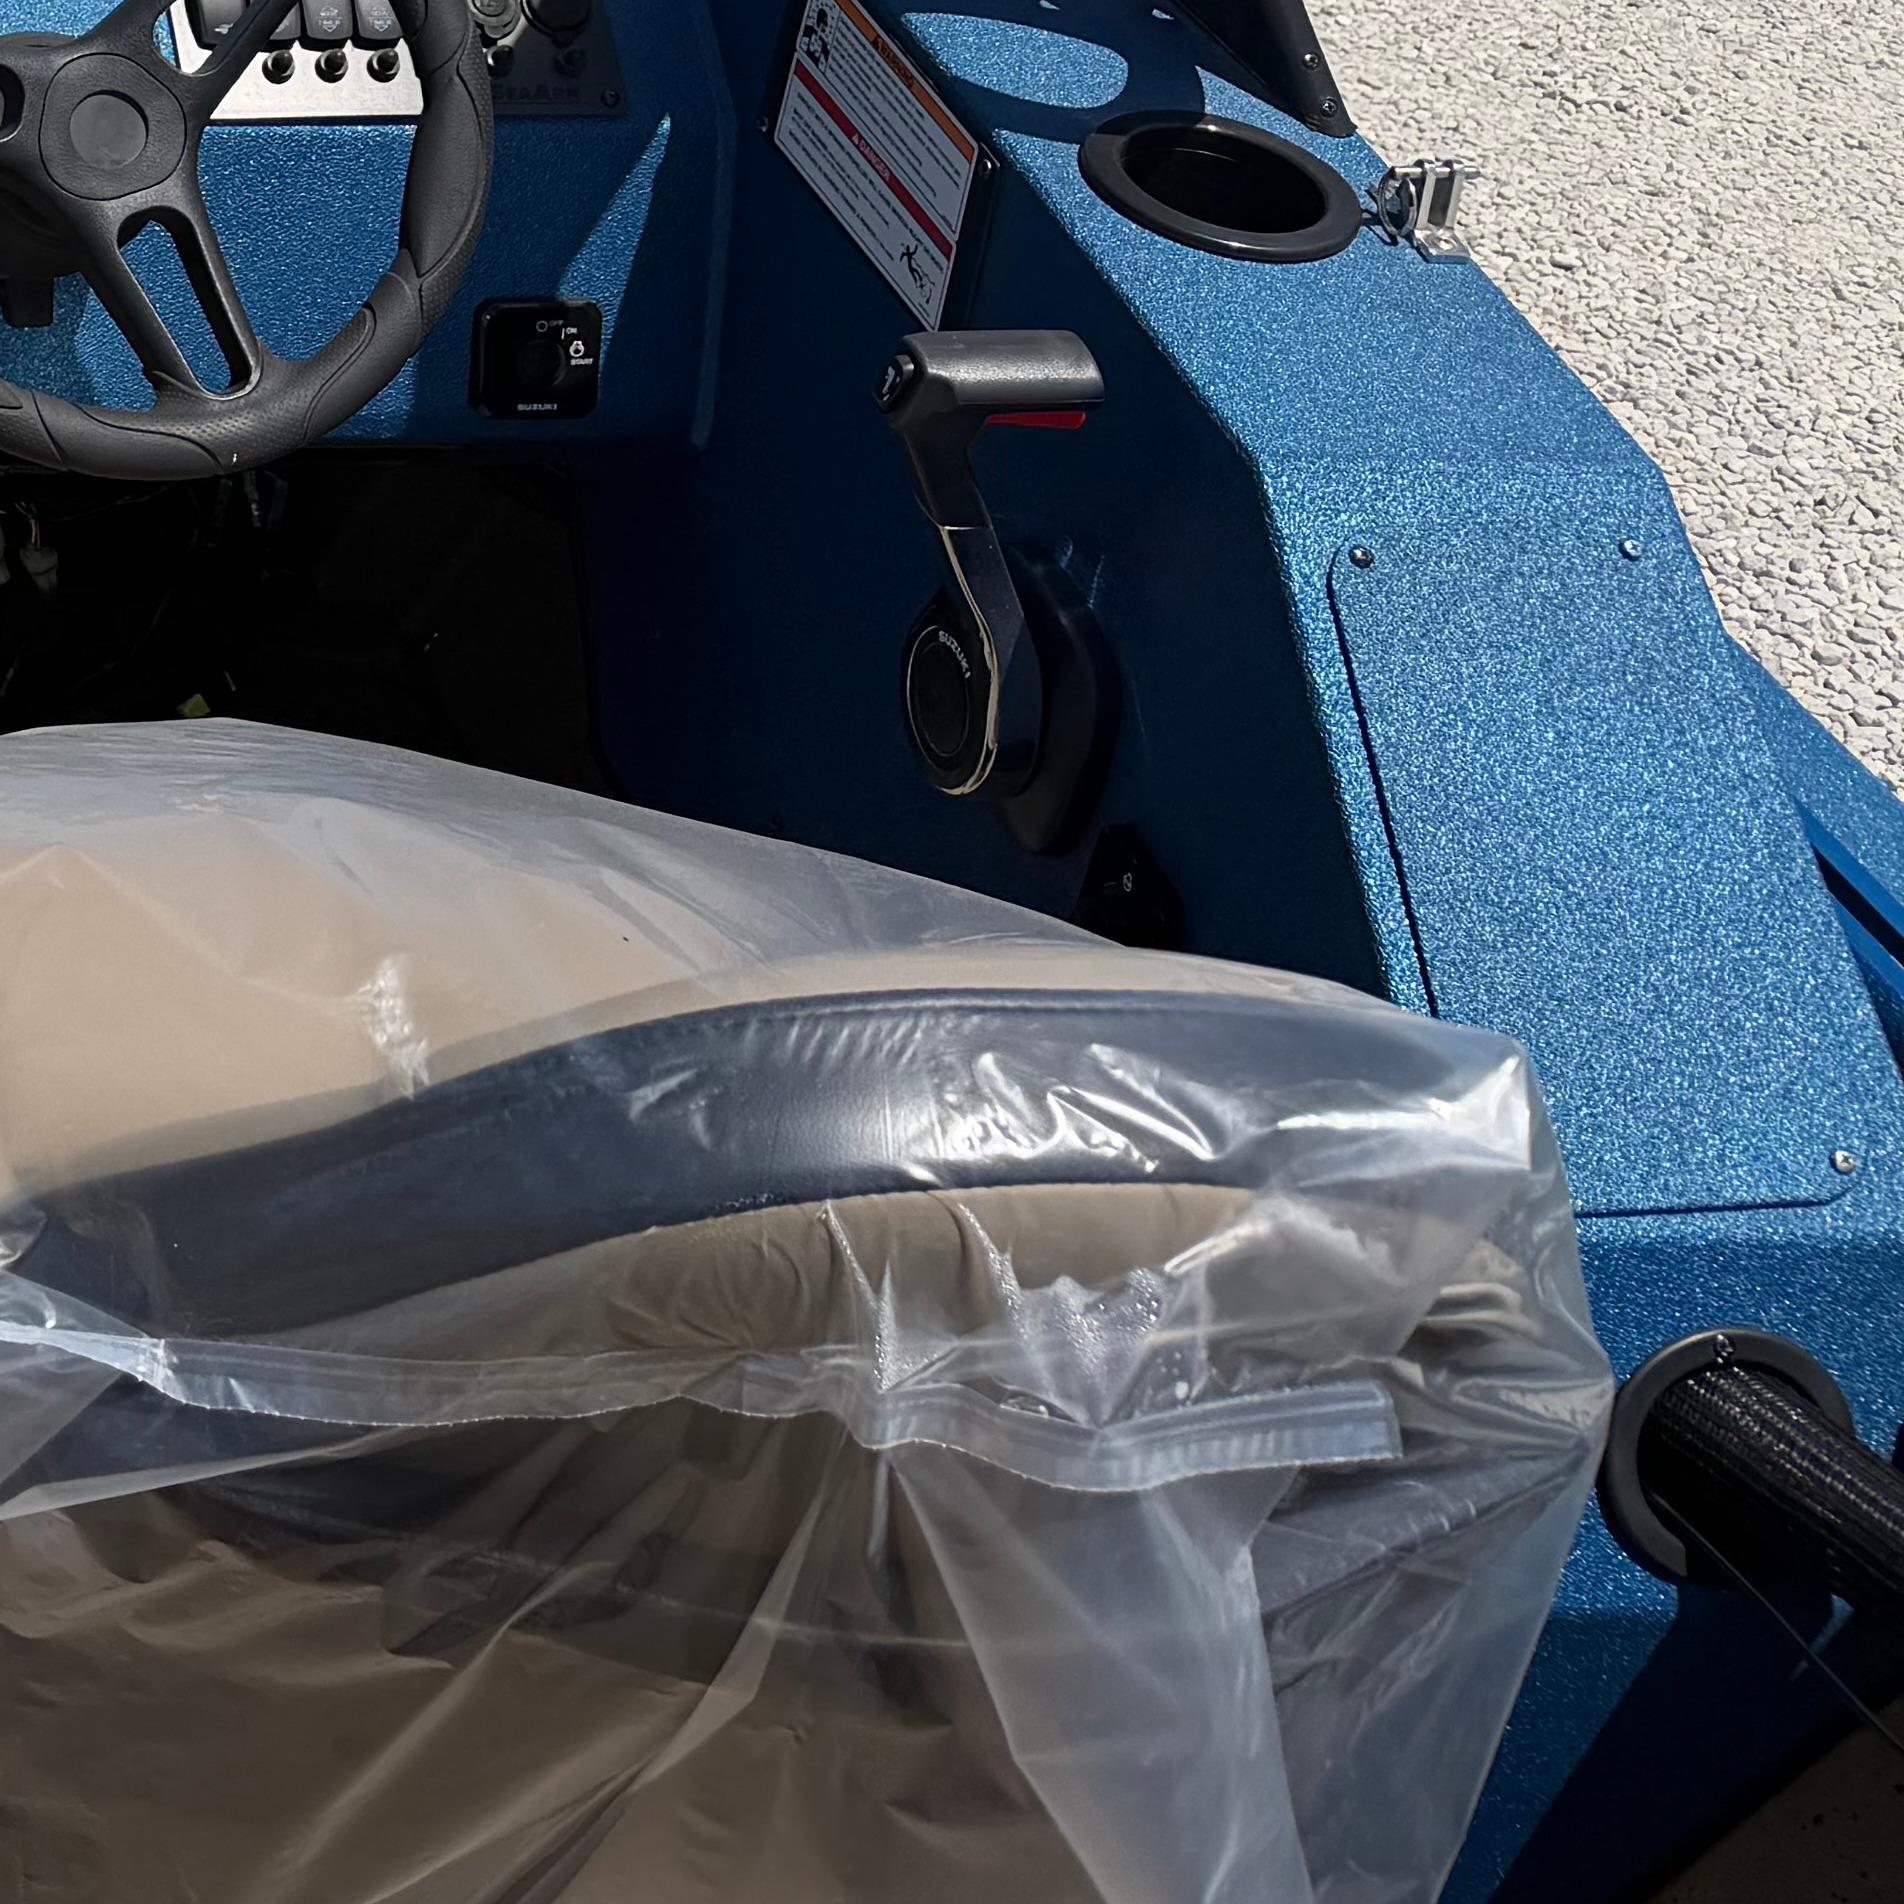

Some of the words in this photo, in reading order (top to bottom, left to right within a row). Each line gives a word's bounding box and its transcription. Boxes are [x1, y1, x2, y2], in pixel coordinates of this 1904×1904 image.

[859, 137, 892, 183] DANGER
[517, 403, 558, 411] SUZUKI
[938, 630, 972, 679] SUZUKI
